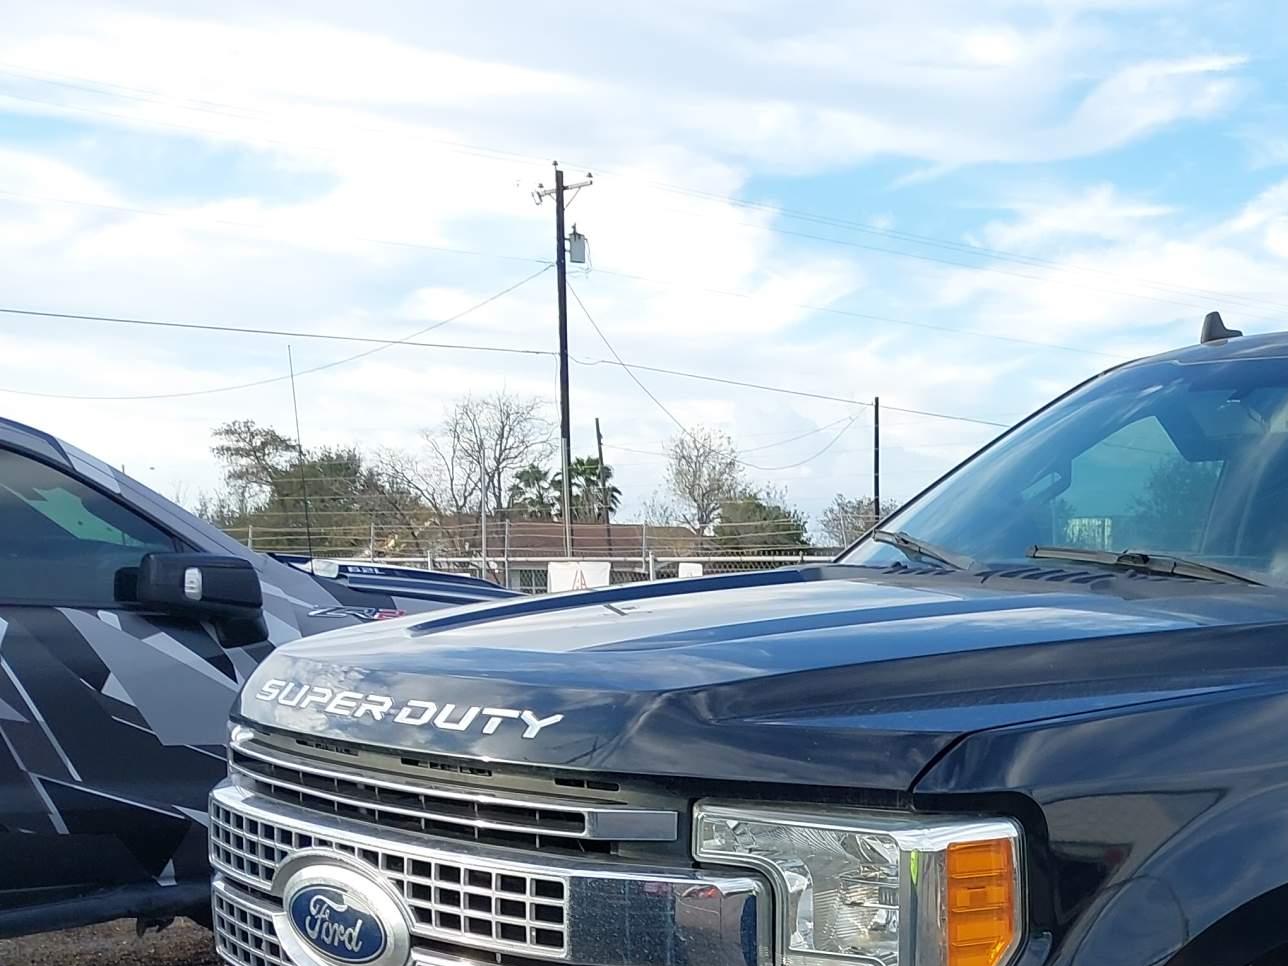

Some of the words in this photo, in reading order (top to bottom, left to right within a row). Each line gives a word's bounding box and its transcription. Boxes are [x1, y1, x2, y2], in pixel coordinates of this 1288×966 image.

[255, 679, 393, 721] SUPER
[393, 699, 565, 739] DUTY
[305, 894, 363, 953] Ford
